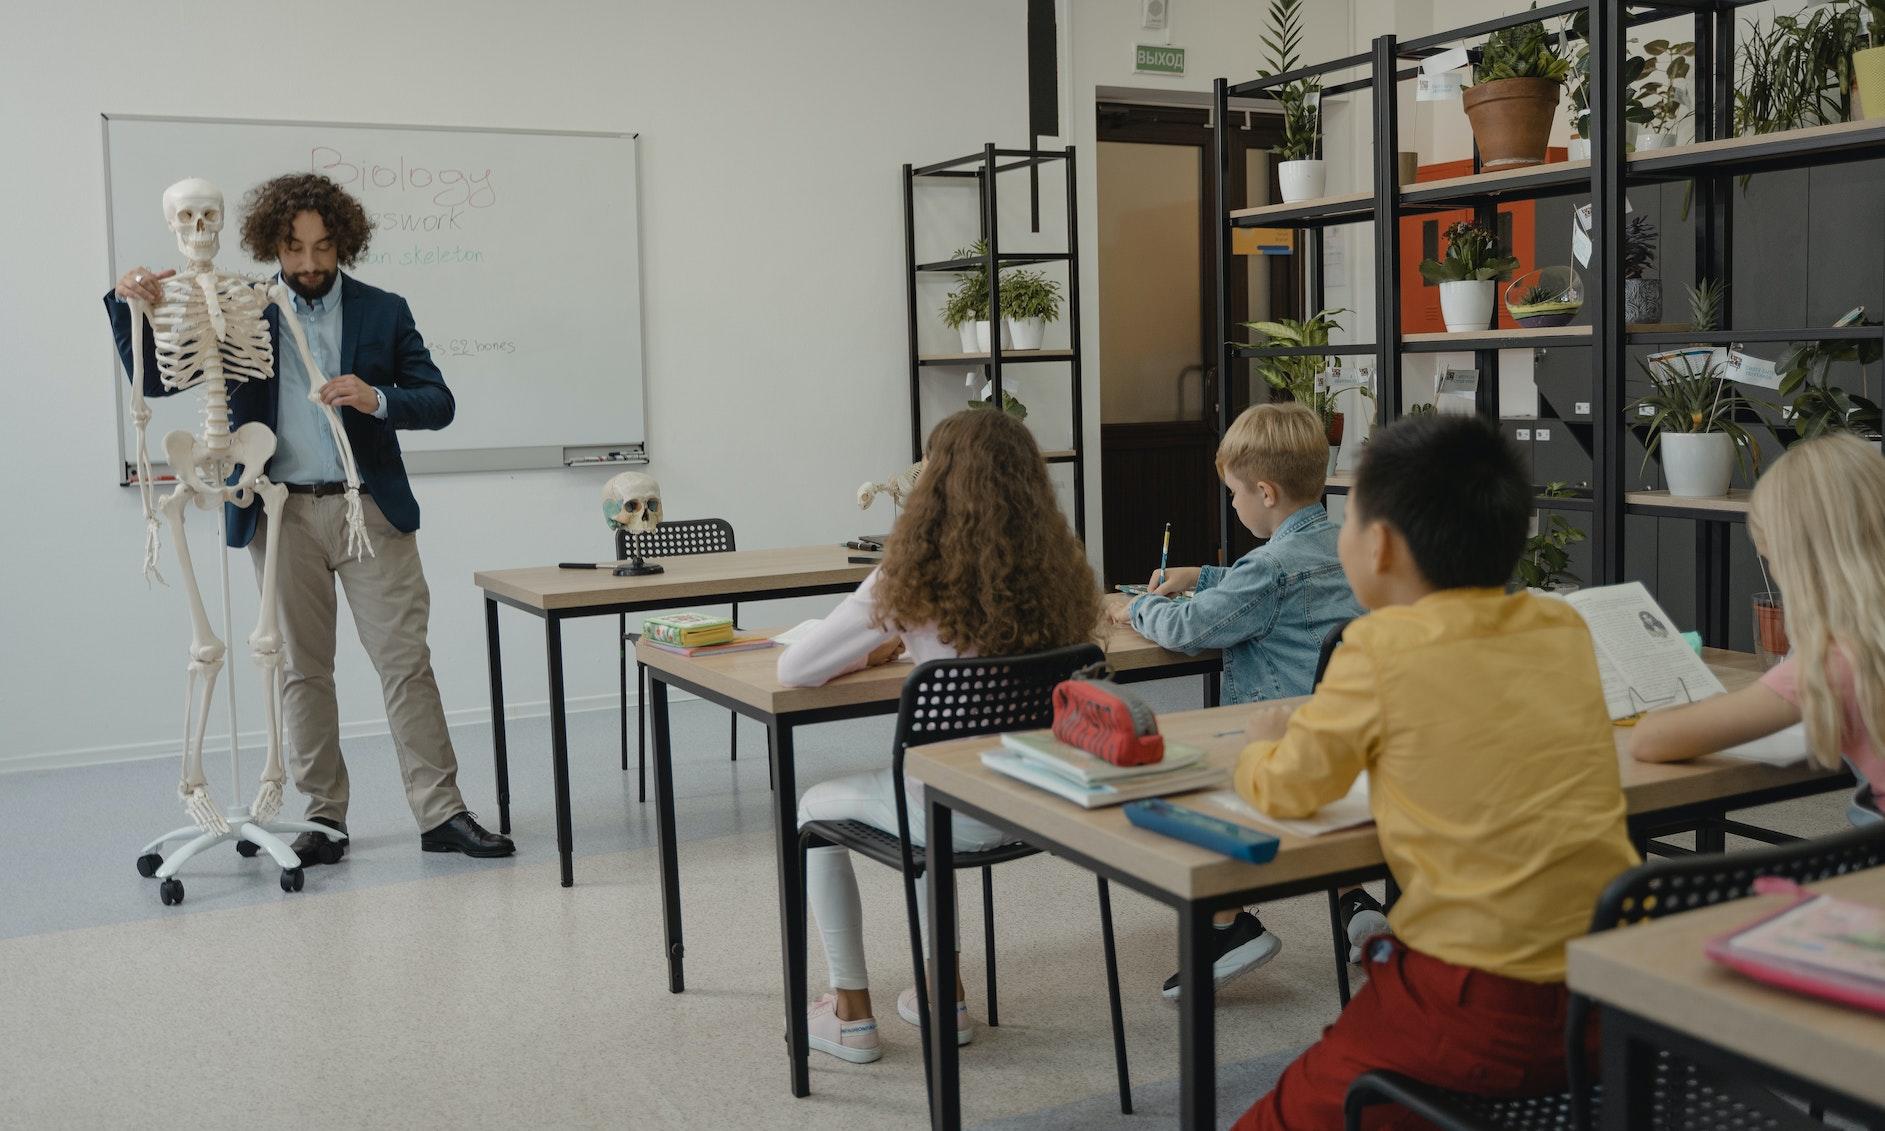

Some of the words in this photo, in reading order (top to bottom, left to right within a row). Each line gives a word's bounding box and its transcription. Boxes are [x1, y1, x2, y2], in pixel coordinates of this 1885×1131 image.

[1137, 50, 1183, 69] ВЫХОД
[311, 146, 496, 208] Biology
[400, 242, 484, 265] skeleton
[474, 338, 516, 354] bones
